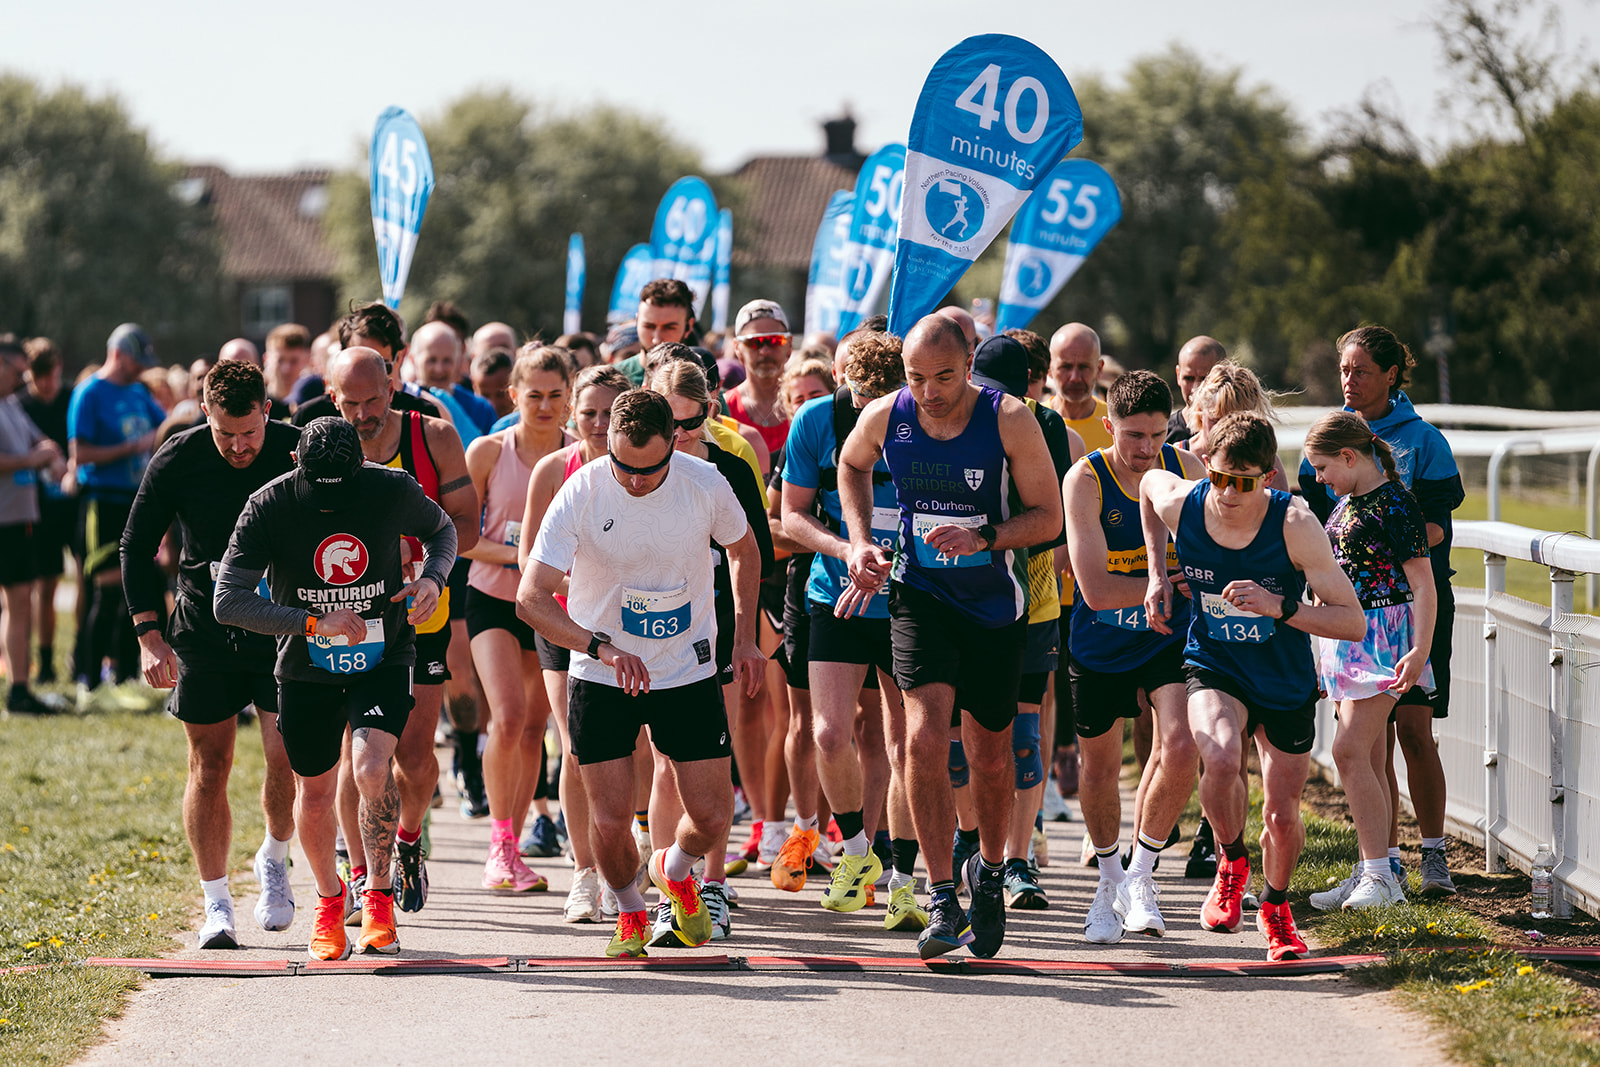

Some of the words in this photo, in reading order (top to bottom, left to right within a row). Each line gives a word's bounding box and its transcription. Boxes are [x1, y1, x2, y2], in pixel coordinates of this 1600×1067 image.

[955, 63, 1050, 144] 40
[378, 132, 418, 196] 45
[951, 136, 1036, 180] minutes
[920, 171, 945, 190] Northern
[945, 169, 968, 181] Pacing
[968, 176, 990, 209] Volunteers
[1041, 178, 1101, 230] 55
[911, 461, 953, 477] ELVET
[901, 477, 966, 495] STRIDERS
[915, 500, 929, 510] Co
[931, 500, 976, 511] Durham
[1107, 556, 1120, 566] LE
[1184, 565, 1215, 581] GBR
[297, 579, 386, 603] CENTURION
[626, 593, 645, 602] TEWV
[312, 599, 373, 615] FITNESS
[626, 600, 648, 612] 10k
[1205, 605, 1226, 616] 10k
[639, 616, 679, 638] 163
[1220, 622, 1262, 642] 134
[312, 634, 332, 646] 10k
[325, 652, 367, 673] 158
